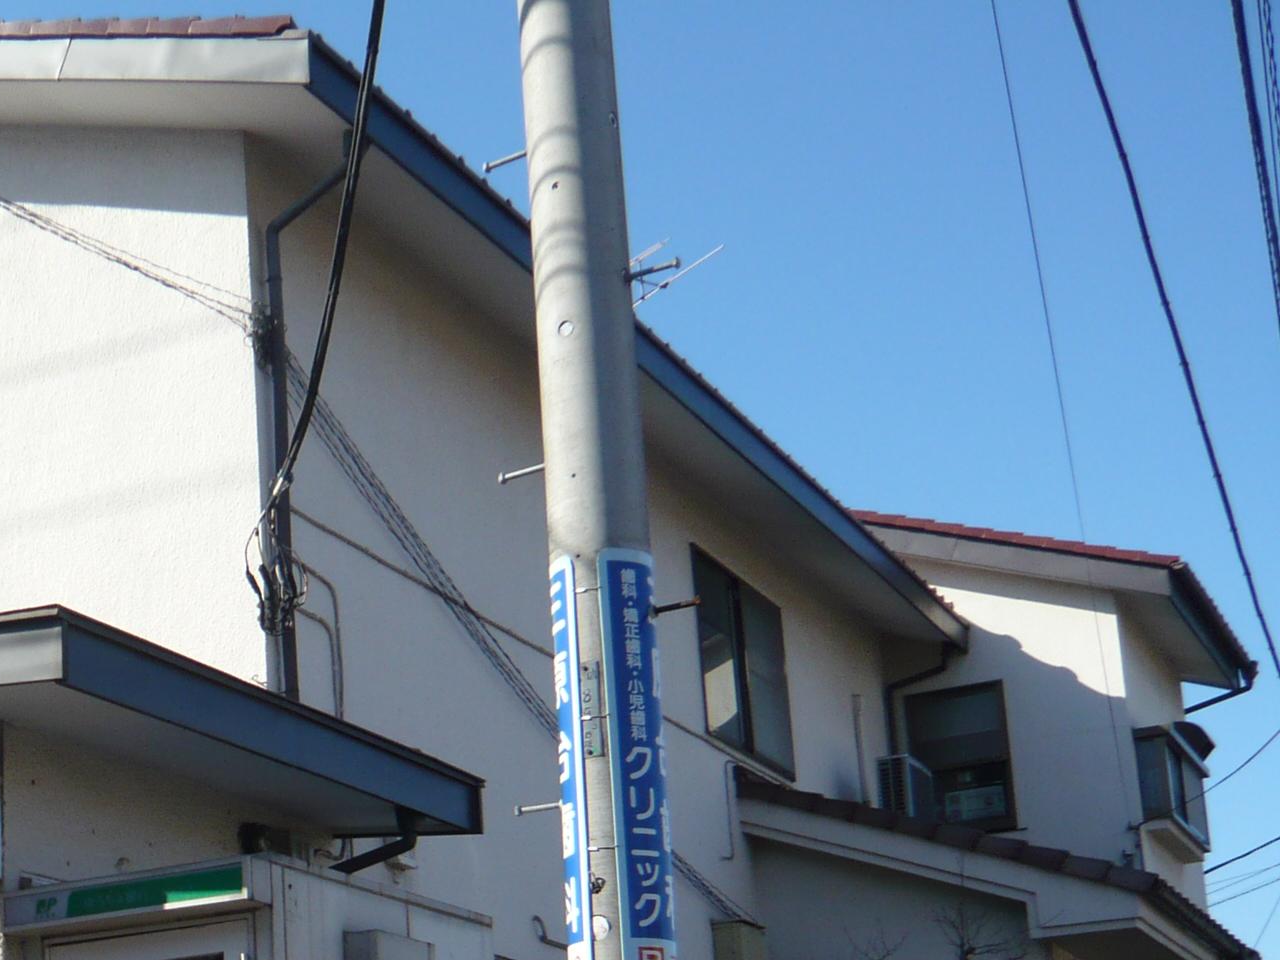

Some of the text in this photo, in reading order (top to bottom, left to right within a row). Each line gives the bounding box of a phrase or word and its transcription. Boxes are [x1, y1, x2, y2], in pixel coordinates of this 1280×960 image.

[625, 746, 662, 928] クリニック
